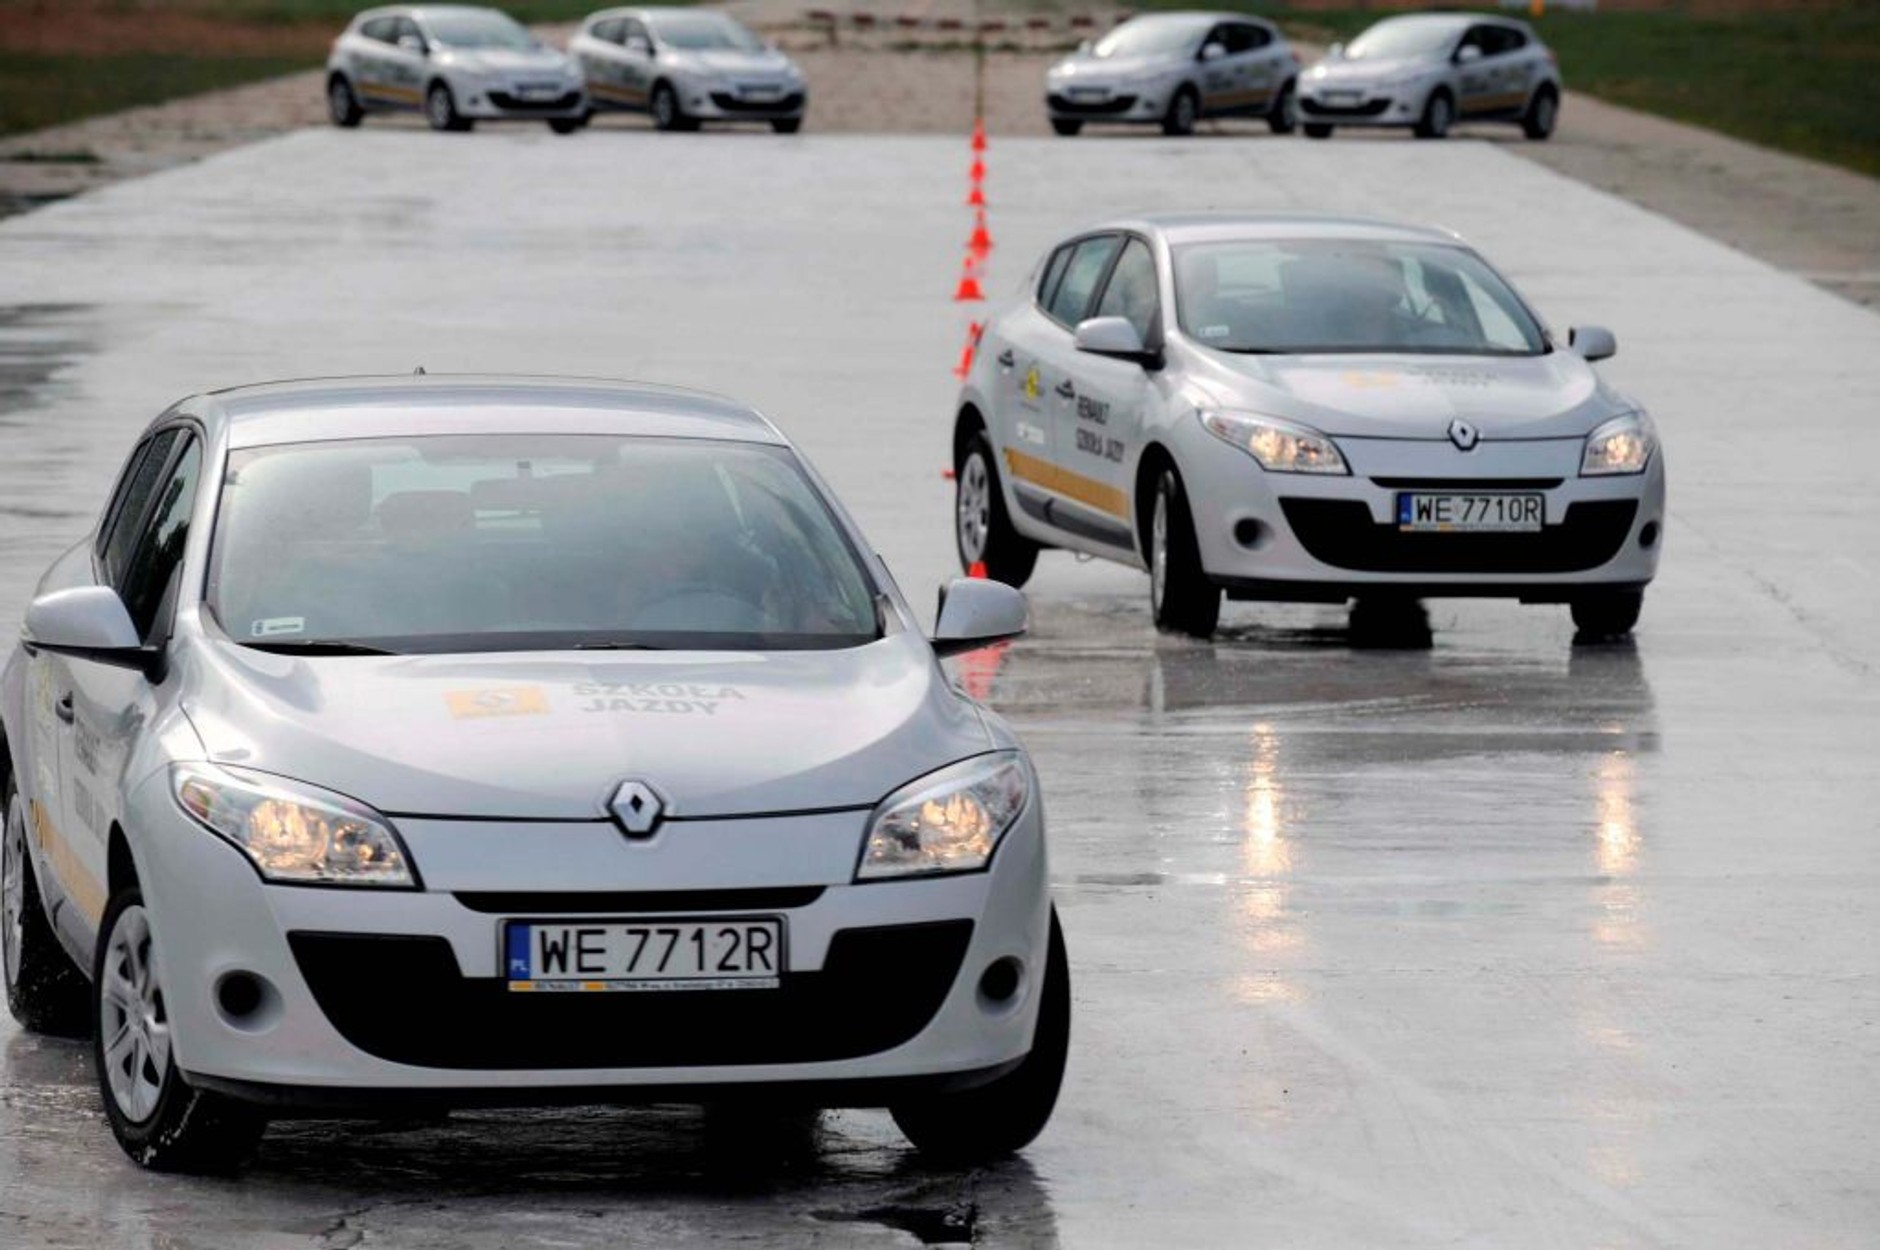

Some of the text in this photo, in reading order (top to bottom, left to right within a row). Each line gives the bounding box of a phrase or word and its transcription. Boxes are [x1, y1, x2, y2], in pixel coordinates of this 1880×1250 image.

[1416, 497, 1540, 523] WE 7710R
[581, 699, 720, 715] JAZDY
[539, 926, 773, 974] WE 7712R
